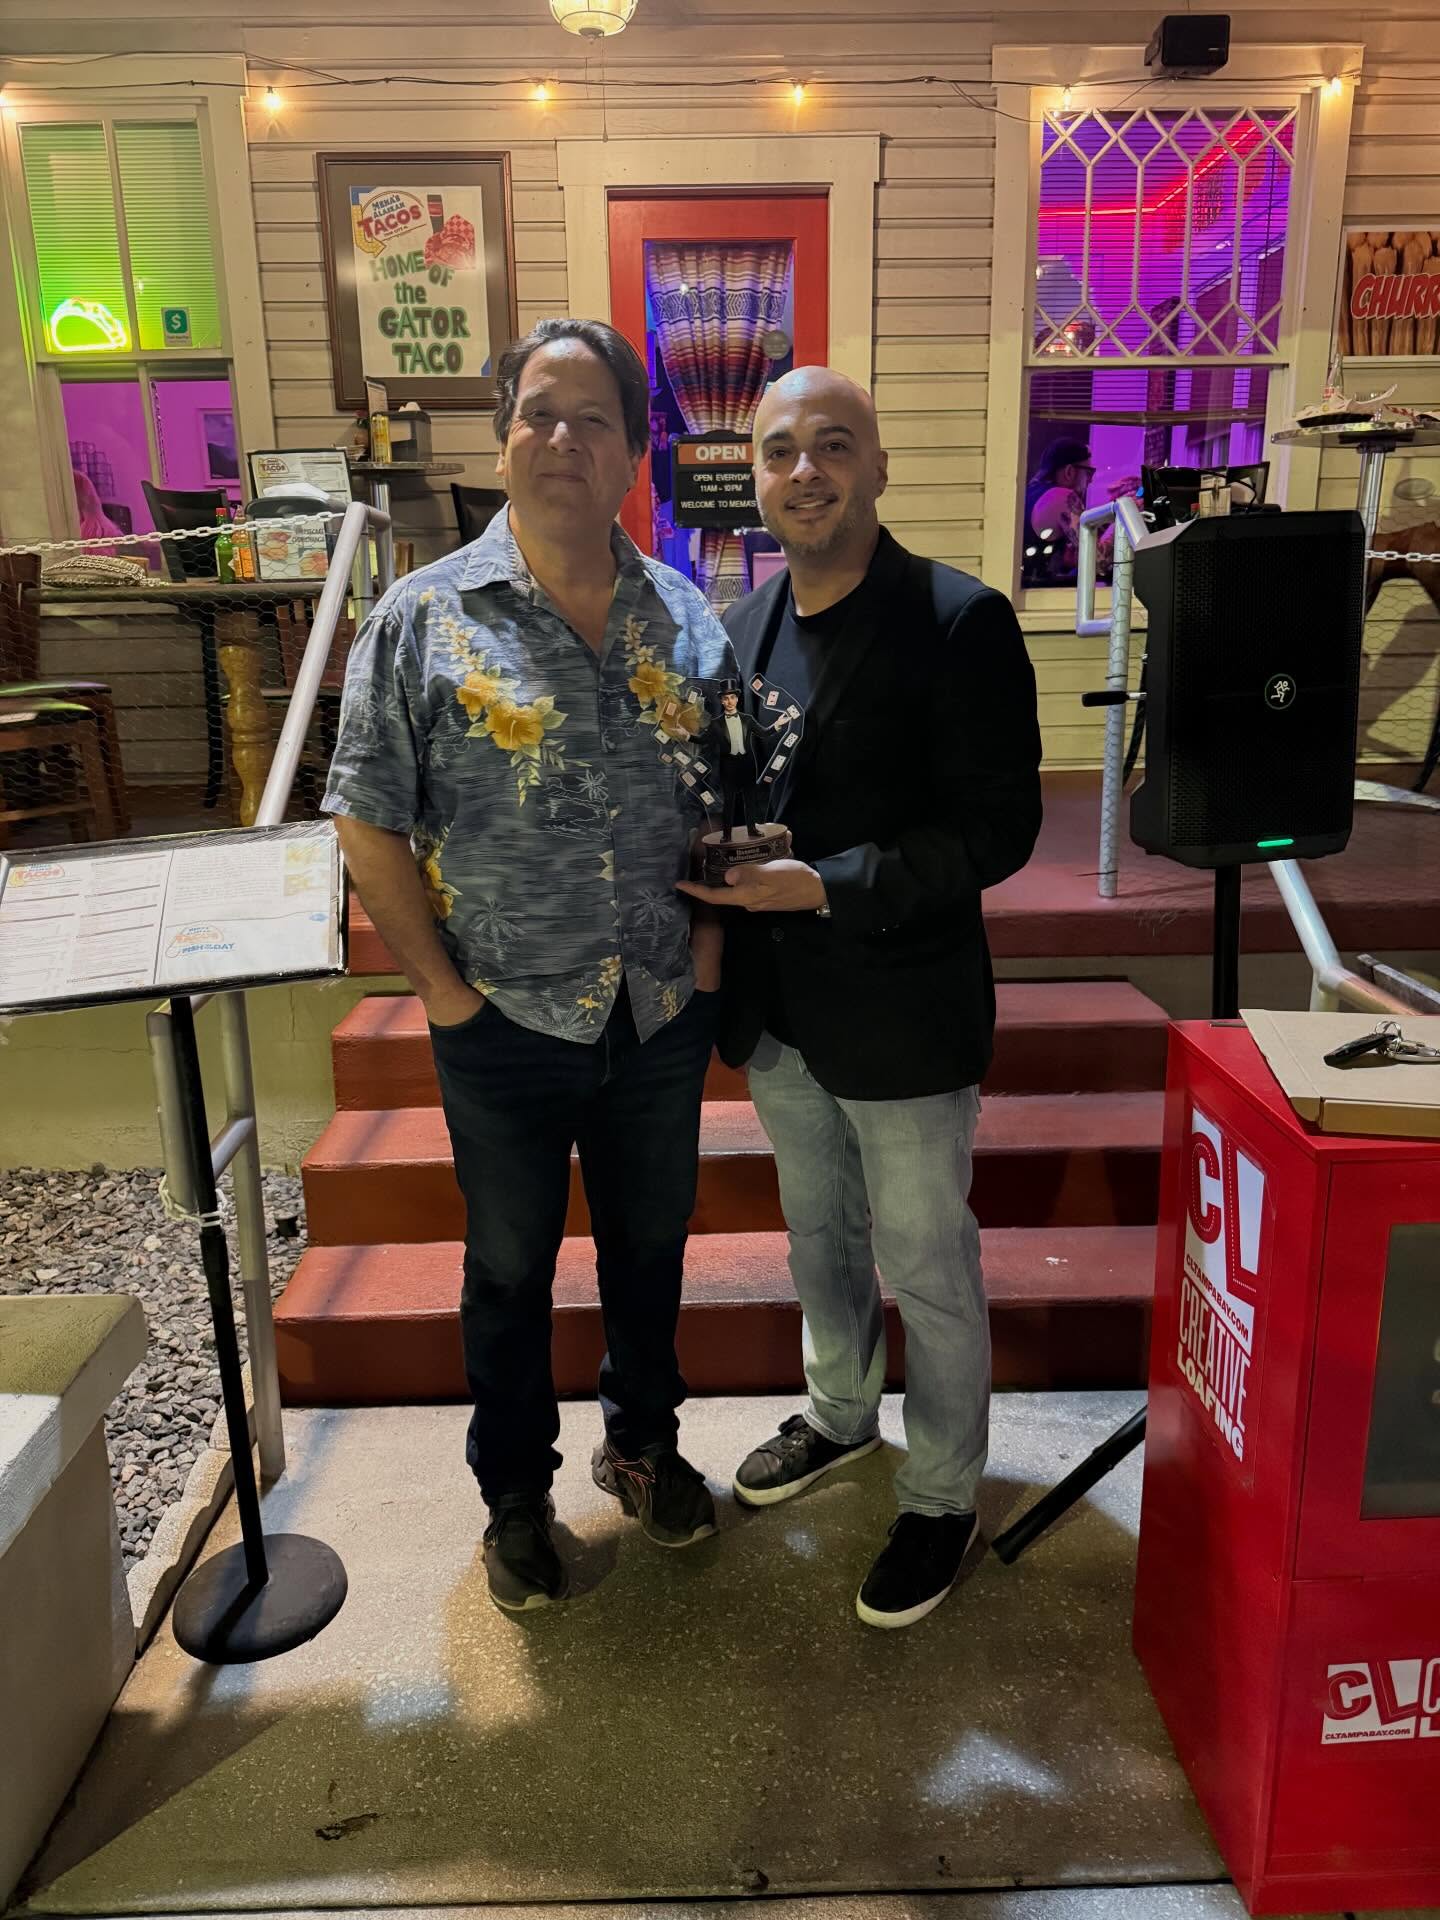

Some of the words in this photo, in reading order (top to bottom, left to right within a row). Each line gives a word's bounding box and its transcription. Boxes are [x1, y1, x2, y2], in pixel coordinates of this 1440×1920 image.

[357, 205, 422, 238] TACOS
[369, 250, 426, 282] HOME
[429, 265, 455, 287] OF
[394, 282, 426, 304] the
[378, 307, 471, 339] GATOR
[392, 342, 464, 374] TACO
[695, 445, 747, 460] OPEN
[693, 474, 713, 482] OPEN
[716, 473, 751, 481] EVERYDAY
[681, 500, 715, 508] WELCOME
[718, 500, 728, 508] TO
[1186, 1253, 1249, 1342] CLTAMPABAY.COM
[1179, 1276, 1251, 1433] CREATIVE
[1177, 1341, 1244, 1462] LOAFING
[1325, 1728, 1411, 1740] CLTAMPABAY.COM
